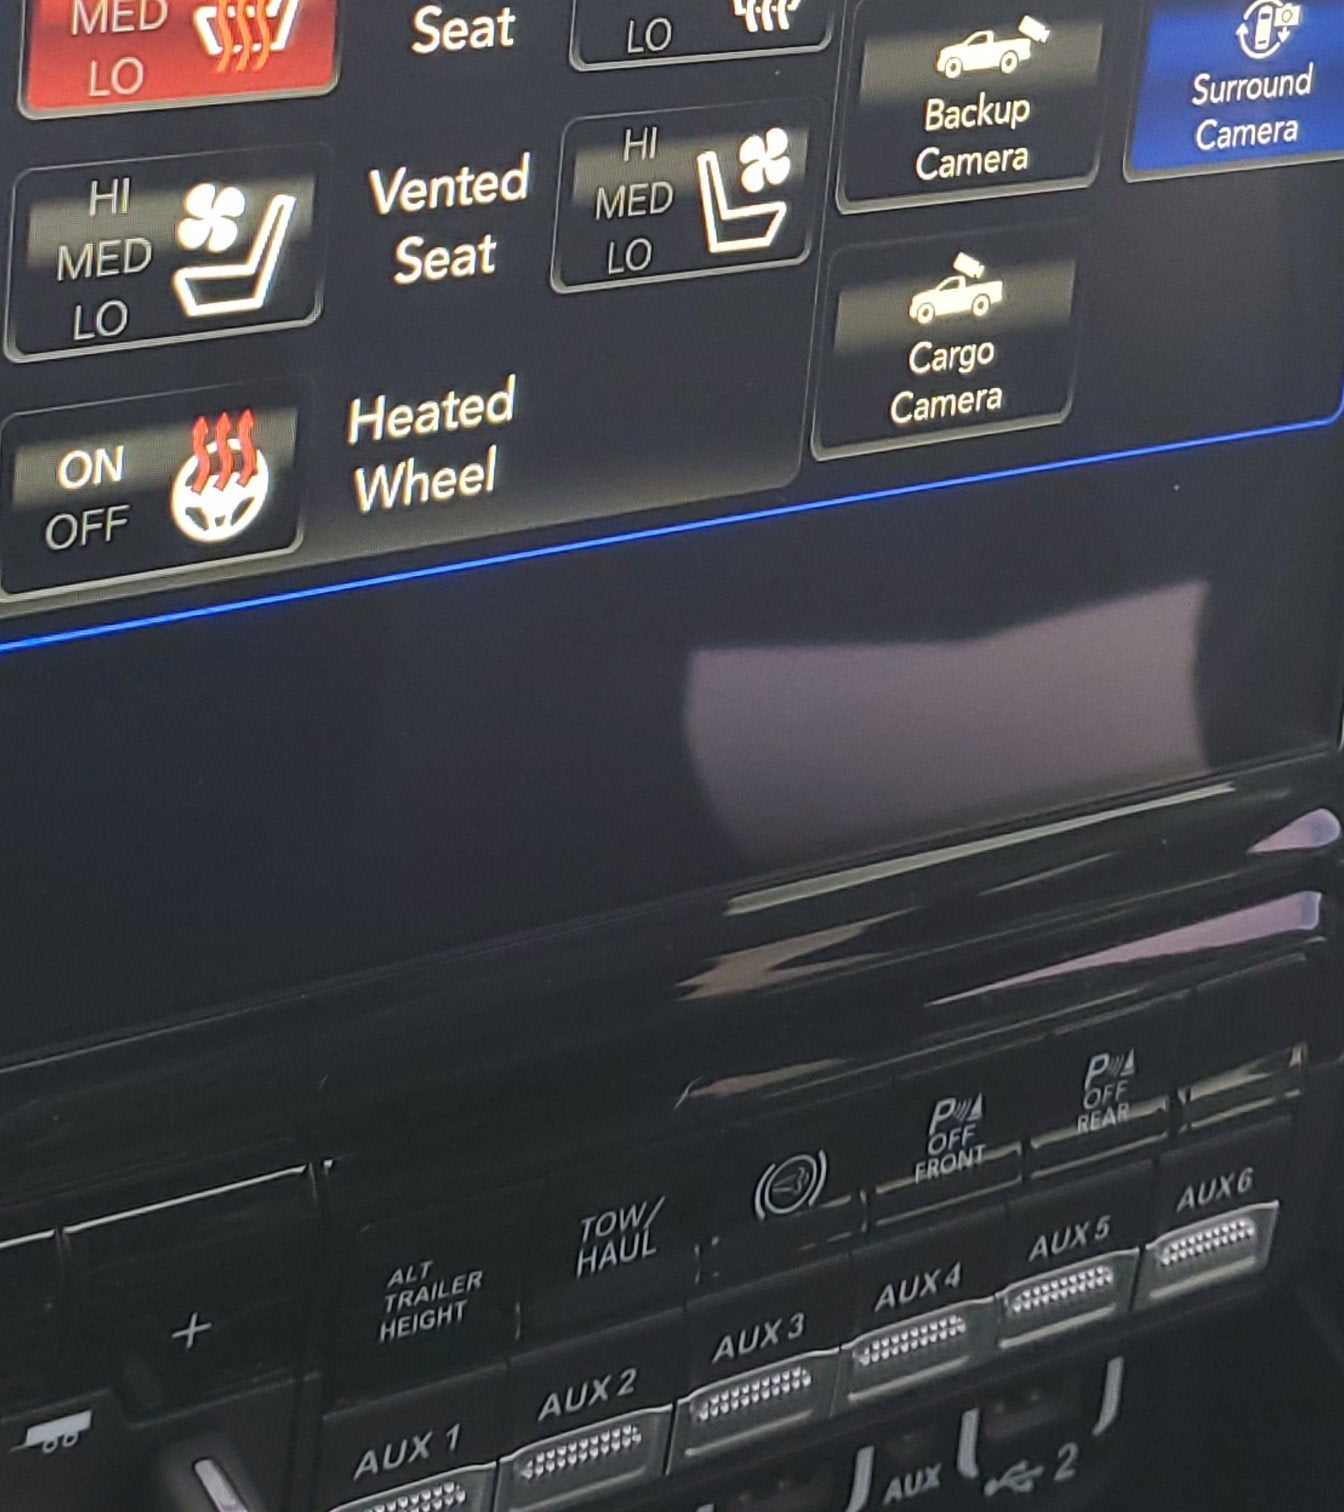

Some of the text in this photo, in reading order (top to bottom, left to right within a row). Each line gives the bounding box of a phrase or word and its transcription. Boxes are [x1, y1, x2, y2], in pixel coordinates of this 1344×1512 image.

[412, 6, 516, 55] Seat
[627, 19, 672, 55] LO
[89, 58, 144, 98] LO
[1191, 63, 1313, 106] Surround
[924, 98, 1030, 133] Backup
[1196, 118, 1298, 151] Camera
[623, 128, 657, 162] HI
[915, 145, 1028, 181] Camera
[89, 178, 130, 217] HI
[370, 153, 531, 217] Vented
[595, 182, 674, 222] MED
[57, 237, 153, 282] MED
[393, 236, 497, 286] Seat
[606, 238, 652, 274] LO
[73, 300, 128, 341] LO
[908, 340, 994, 376] Cargo
[347, 375, 517, 445] Heated
[890, 384, 1003, 425] Camera
[59, 445, 125, 490] ON
[354, 445, 497, 516] Wheel
[45, 506, 130, 551] OFF
[1083, 1080, 1129, 1110] OFF
[1077, 1102, 1130, 1133] REAR
[928, 1125, 976, 1155] OFF
[914, 1146, 986, 1184] FRONT
[1177, 1167, 1255, 1212] AUX 6
[576, 1230, 657, 1277] HAUL
[1028, 1217, 1110, 1261] AUX 5
[383, 1270, 483, 1313] TRAILER
[387, 1260, 434, 1287] ALT
[874, 1261, 963, 1312] AUX 4
[379, 1299, 467, 1343] HEIGHT
[712, 1314, 805, 1363] AUX 3
[538, 1369, 637, 1420] AUX 2
[353, 1424, 460, 1480] AUX 1
[884, 1443, 1078, 1506] AUX 2
